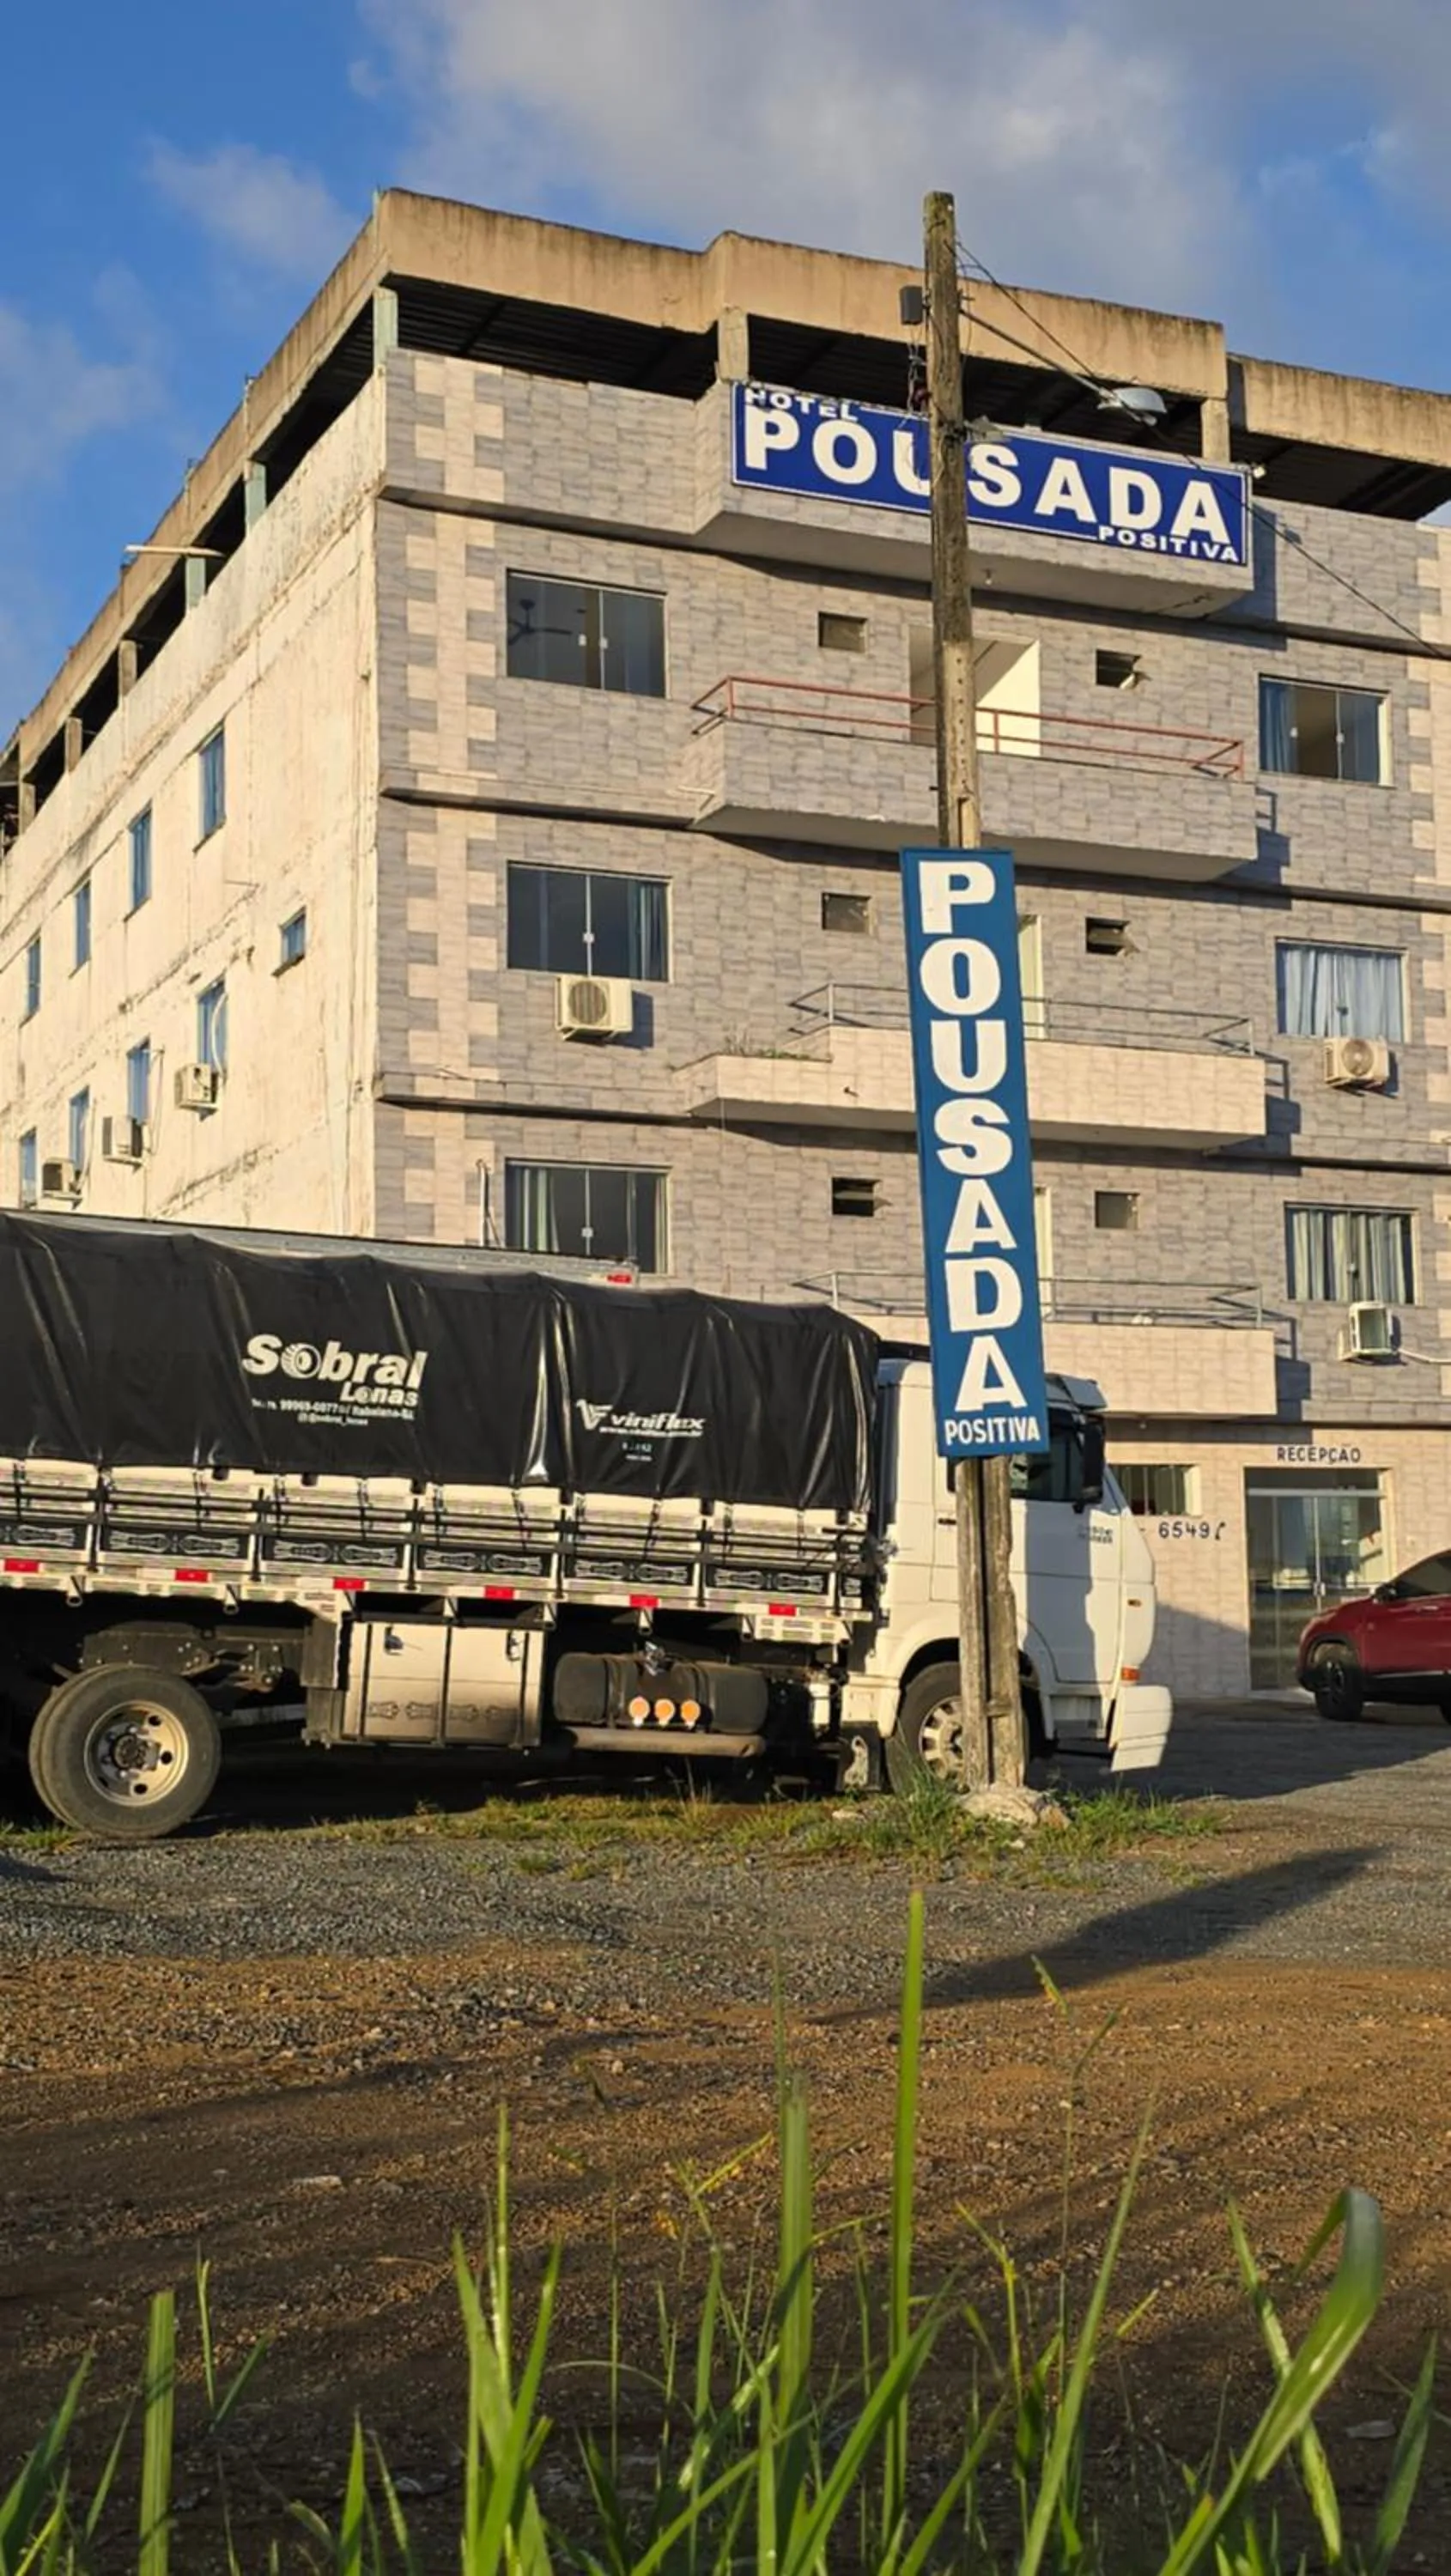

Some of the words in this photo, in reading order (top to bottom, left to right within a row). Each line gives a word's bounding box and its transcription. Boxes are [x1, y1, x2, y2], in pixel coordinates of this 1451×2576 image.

[745, 387, 858, 422] HOTEL
[744, 404, 1231, 544] POUSADA
[1098, 525, 1239, 562] POSITIVA
[918, 860, 1028, 1411] POUSADA
[241, 1334, 428, 1388] Sobral
[340, 1381, 418, 1406] Lonas
[944, 1416, 1041, 1446] POSITIVA
[1158, 1521, 1210, 1539] 6549
